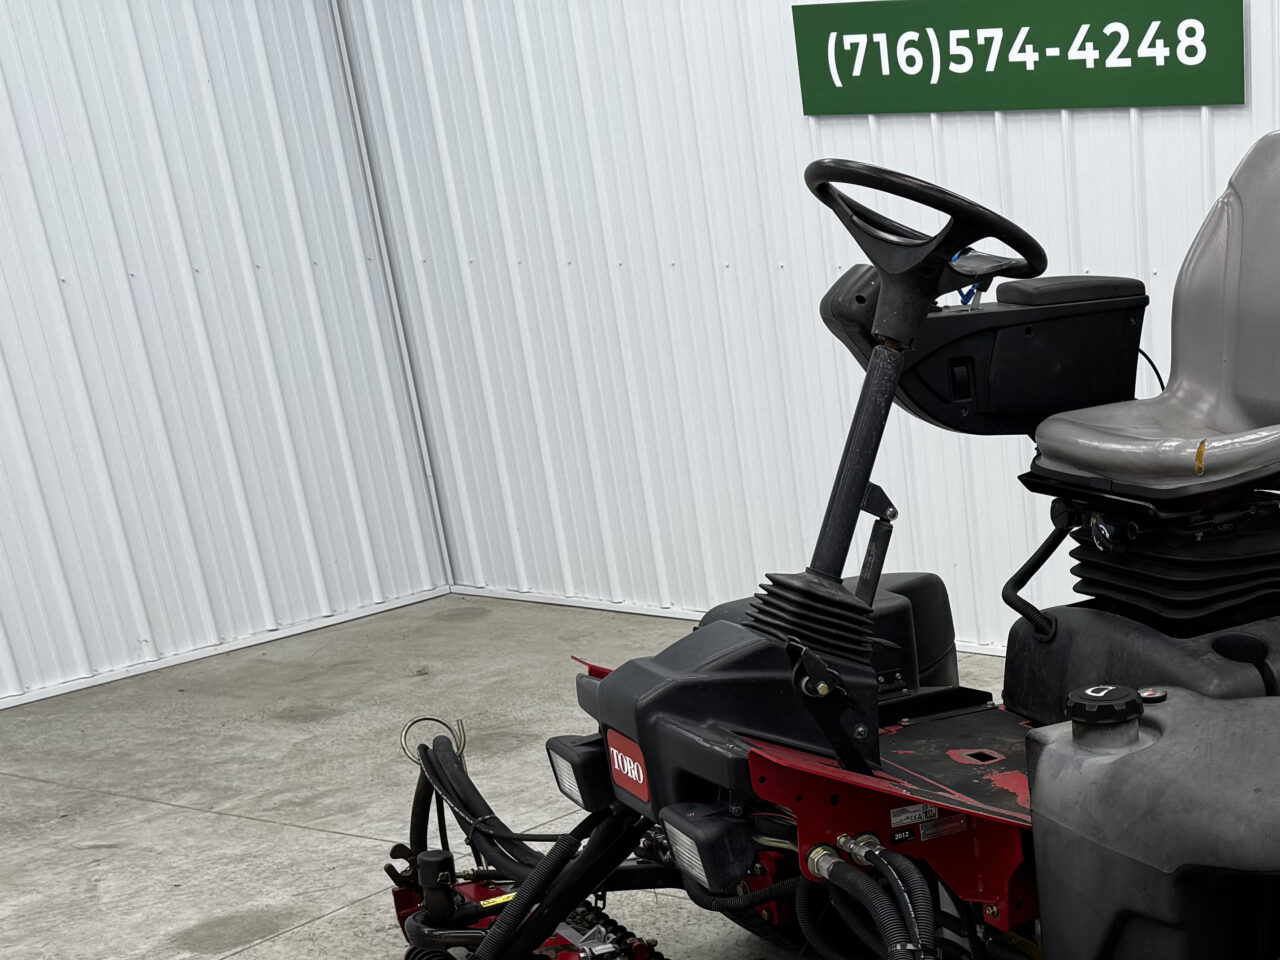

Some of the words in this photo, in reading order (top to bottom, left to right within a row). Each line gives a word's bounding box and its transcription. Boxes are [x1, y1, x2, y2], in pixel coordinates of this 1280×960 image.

[827, 18, 1207, 88] (716)574-4248
[610, 747, 644, 785] TORO
[894, 831, 910, 840] 2012
